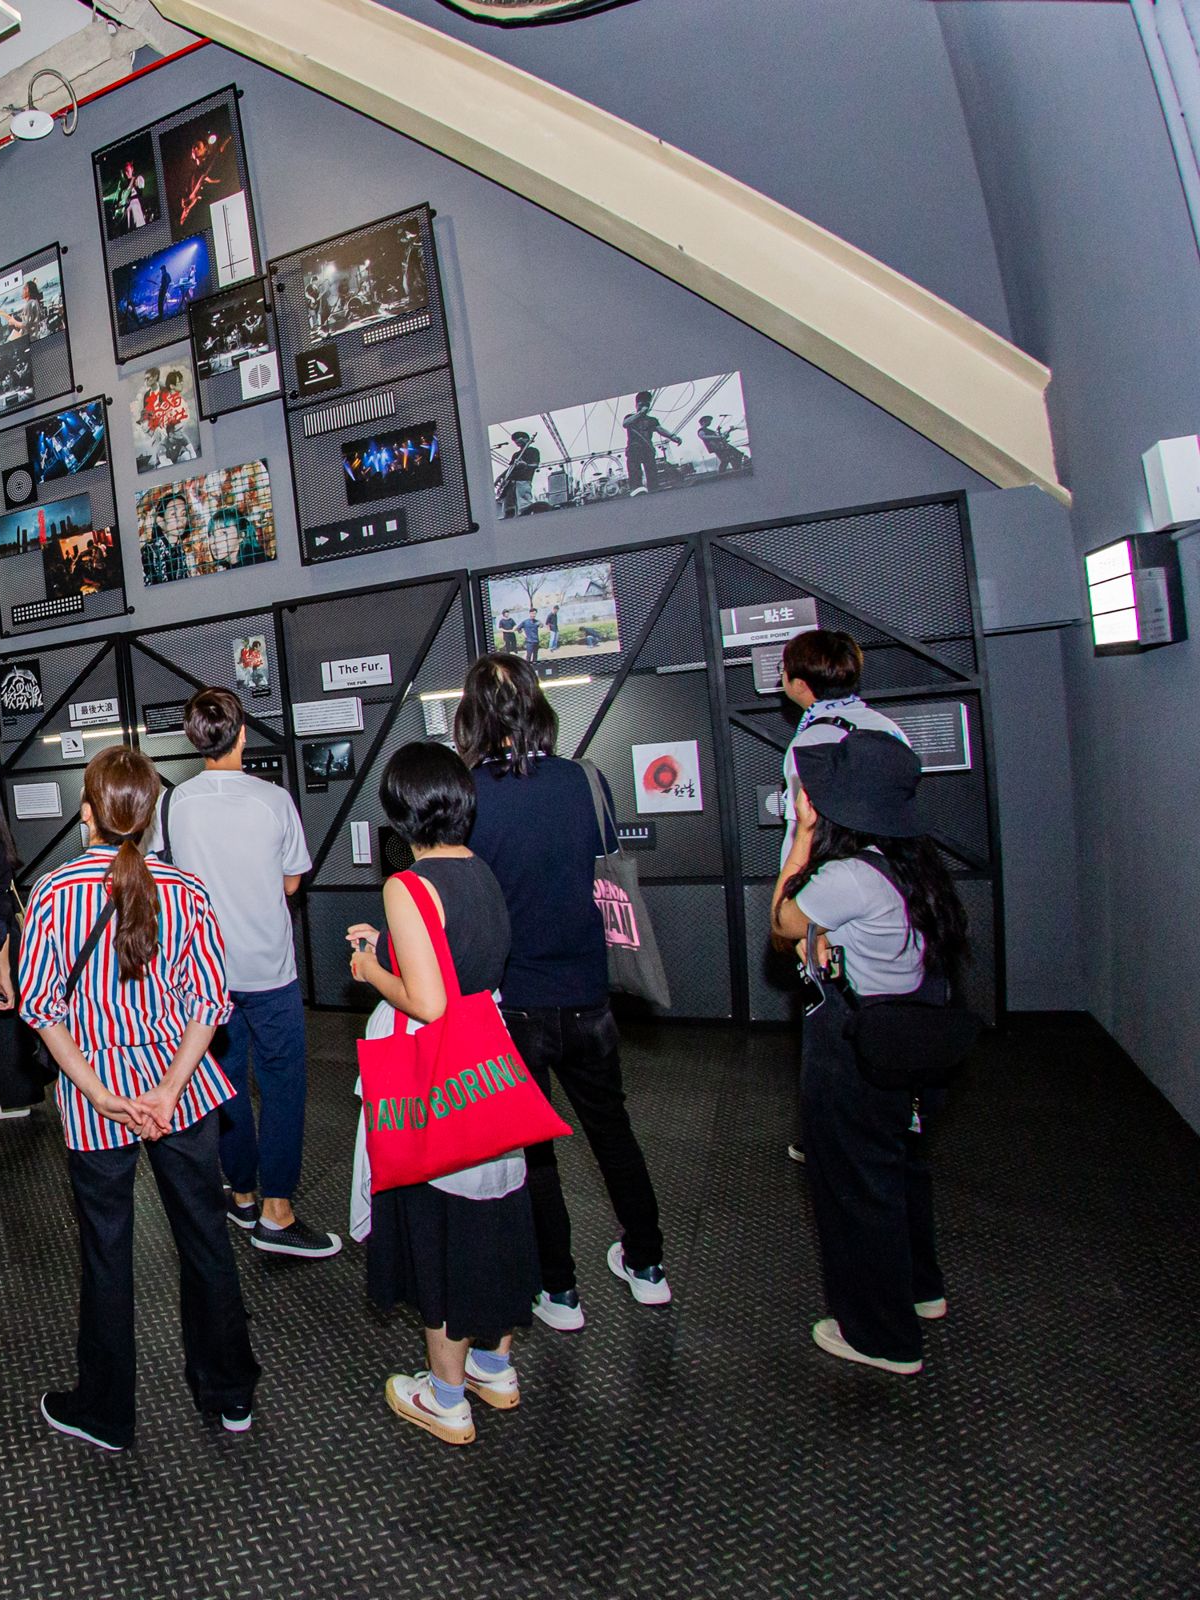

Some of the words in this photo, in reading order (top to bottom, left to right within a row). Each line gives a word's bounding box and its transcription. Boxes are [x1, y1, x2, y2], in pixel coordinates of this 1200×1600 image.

[749, 607, 796, 624] 一點生
[770, 631, 790, 639] POINT
[338, 664, 359, 675] The
[361, 662, 383, 673] Fur.
[81, 702, 114, 715] 最後大浪
[365, 1096, 429, 1132] DAVID
[429, 1053, 528, 1120] BORING
